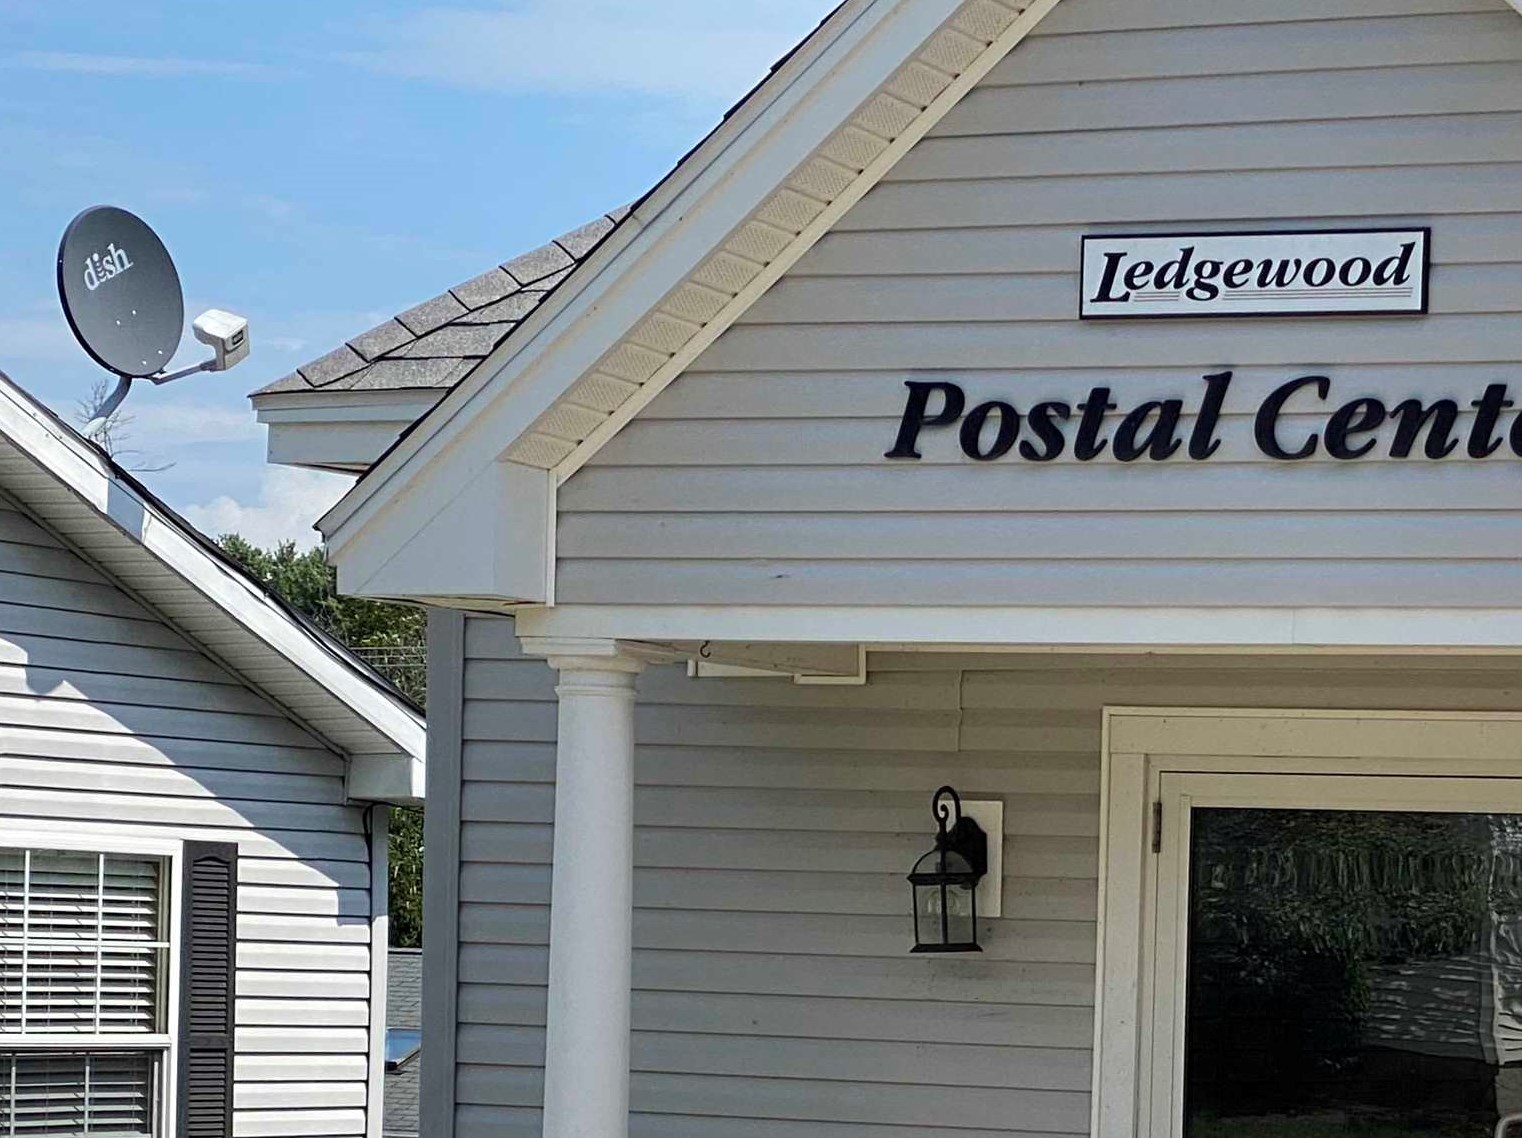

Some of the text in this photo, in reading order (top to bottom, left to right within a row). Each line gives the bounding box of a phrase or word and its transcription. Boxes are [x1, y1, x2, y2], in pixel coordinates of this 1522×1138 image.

[84, 243, 134, 290] dish
[1090, 241, 1417, 303] Ledgewood
[883, 370, 1234, 462] Postal
